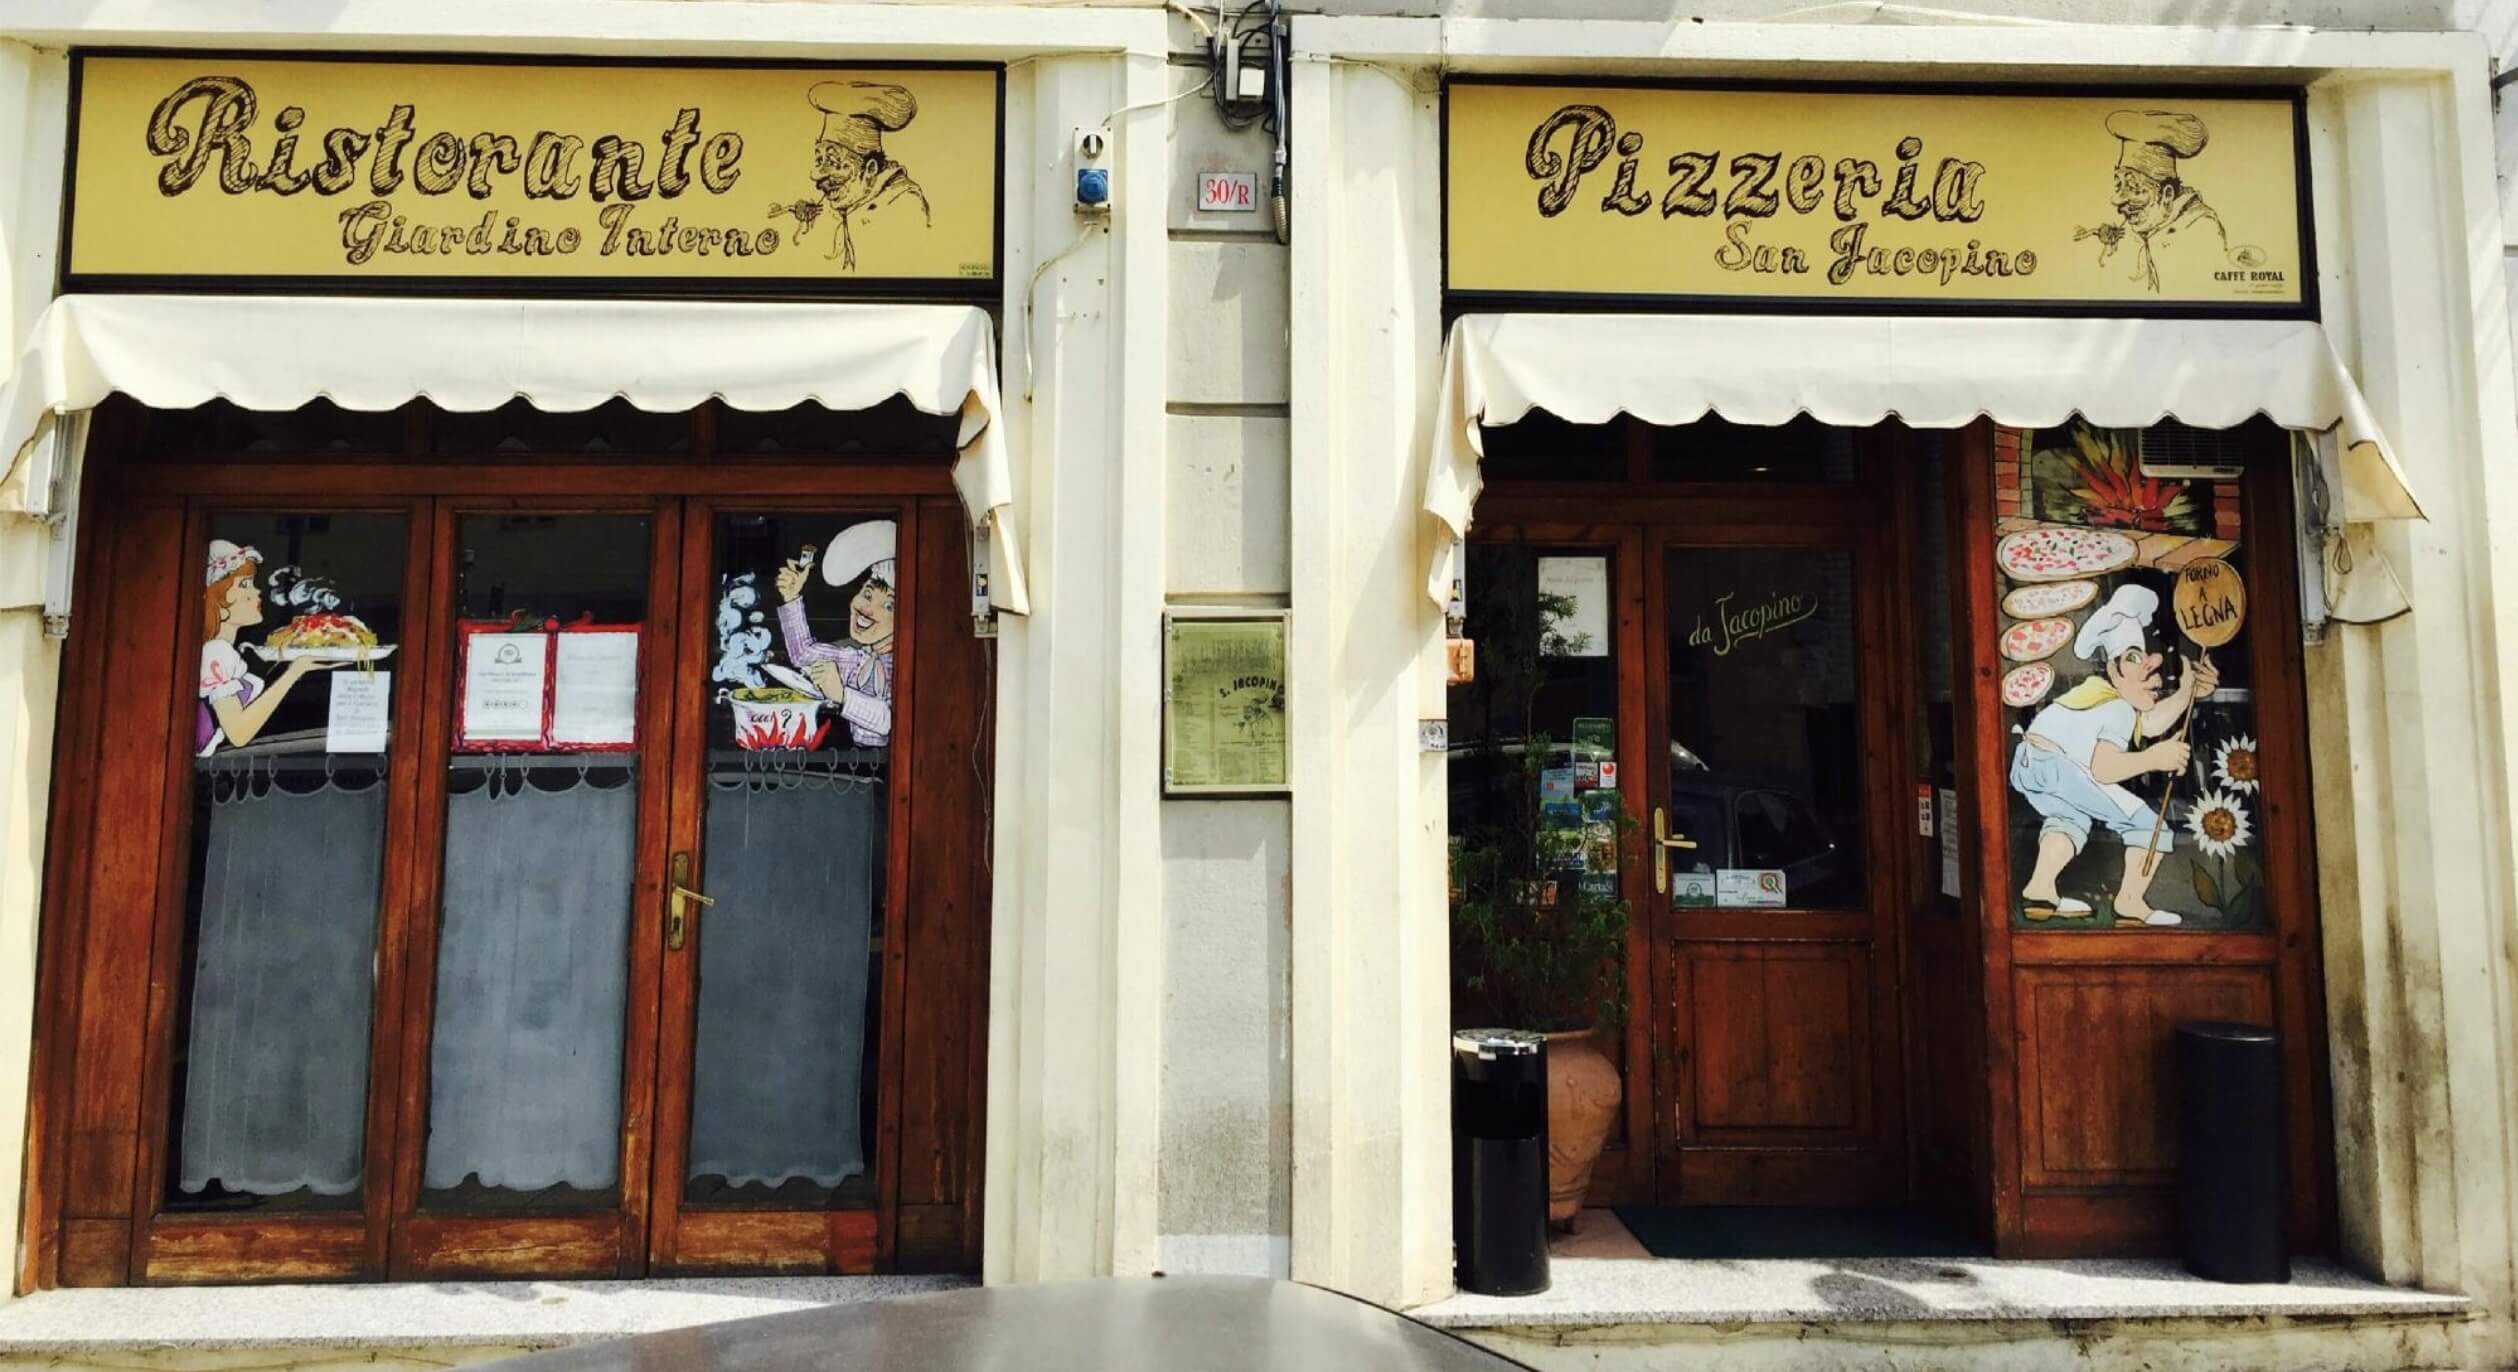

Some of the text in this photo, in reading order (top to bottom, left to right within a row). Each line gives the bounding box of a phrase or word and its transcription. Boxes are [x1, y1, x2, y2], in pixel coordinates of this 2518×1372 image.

[147, 76, 745, 199] Ristorante
[1526, 104, 1986, 222] Pizzeria
[1205, 178, 1250, 206] 30/R
[338, 201, 780, 265] Giardino Interno
[1714, 221, 2037, 285] San Jacopino
[2250, 271, 2285, 281] ROYAL
[2185, 564, 2220, 583] FORNO
[2199, 586, 2208, 602] A
[1689, 591, 1801, 656] da Jacopino
[2180, 595, 2238, 630] LEGNA
